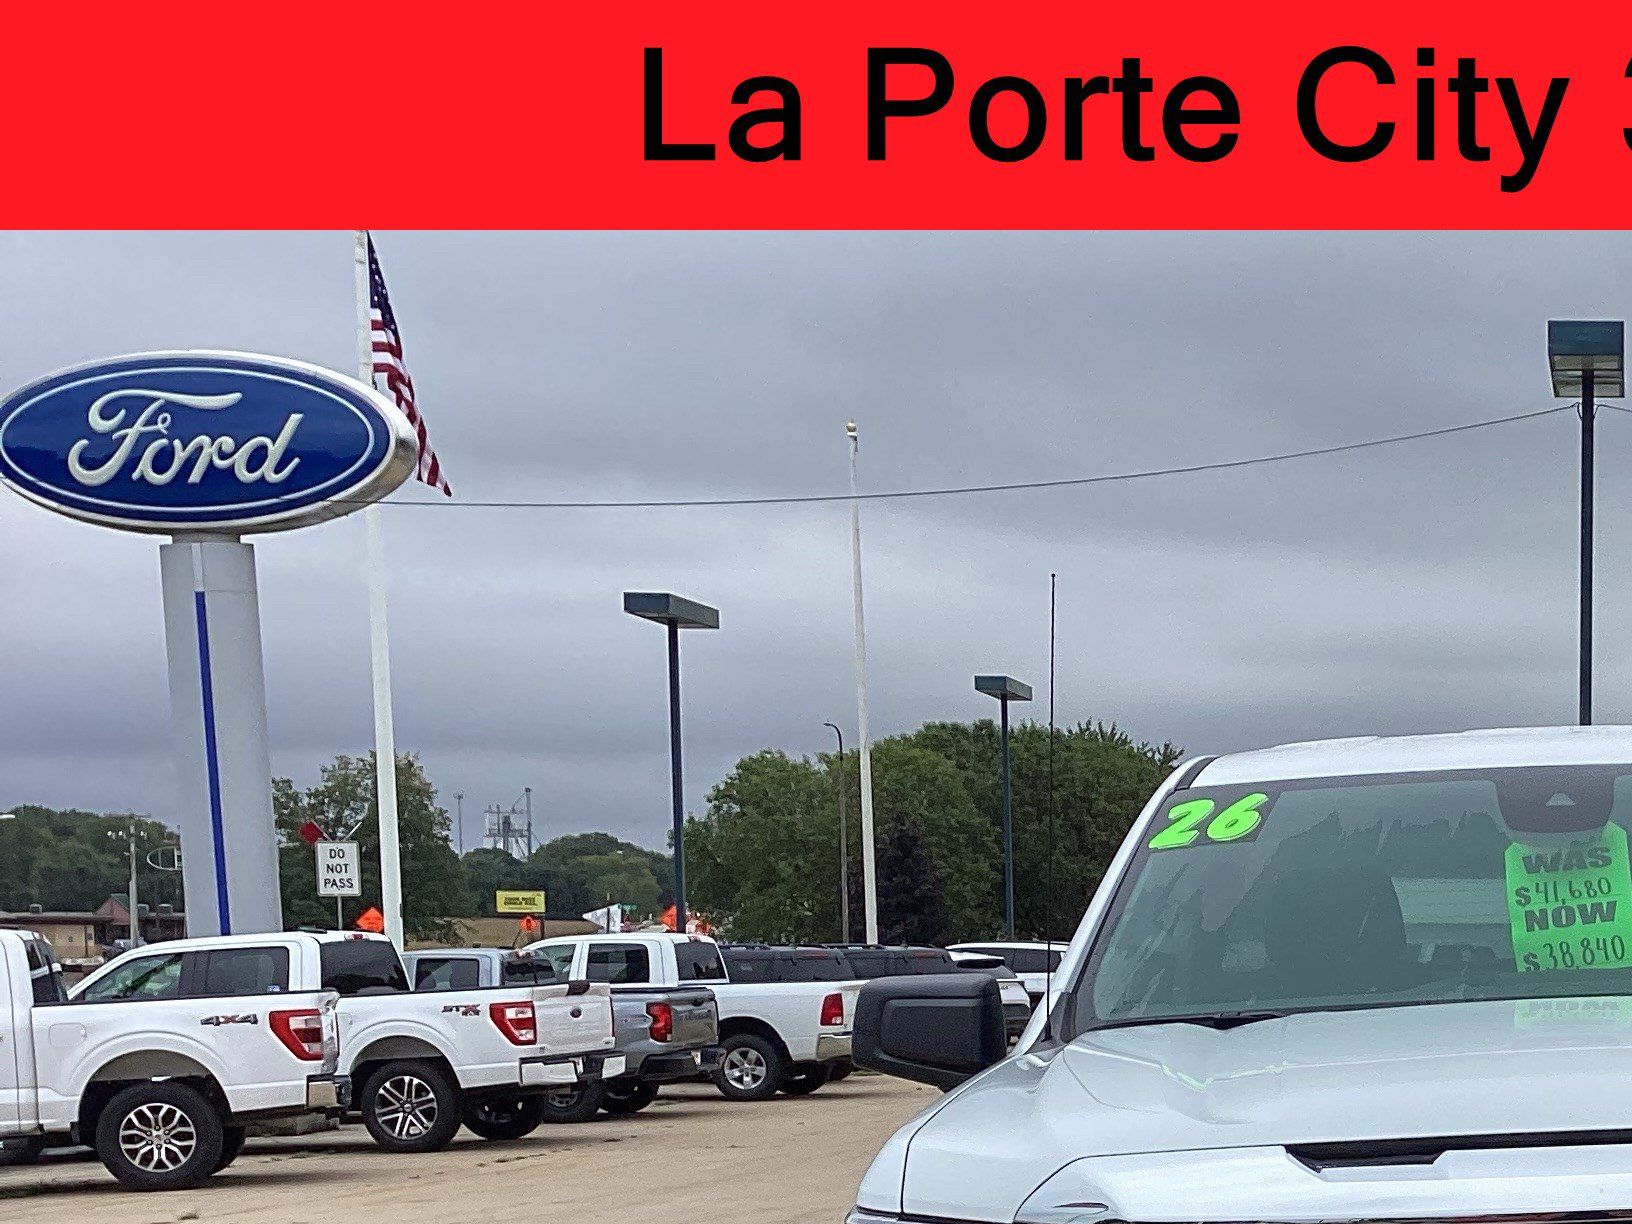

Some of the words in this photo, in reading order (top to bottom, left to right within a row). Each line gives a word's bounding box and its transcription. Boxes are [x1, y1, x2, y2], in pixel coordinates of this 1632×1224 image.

[67, 388, 304, 486] Ford
[1148, 792, 1269, 849] 26
[329, 848, 345, 859] DO
[1521, 846, 1613, 875] WAS
[324, 878, 354, 889] PASS
[326, 864, 349, 874] NOT
[1524, 900, 1618, 932] NOW
